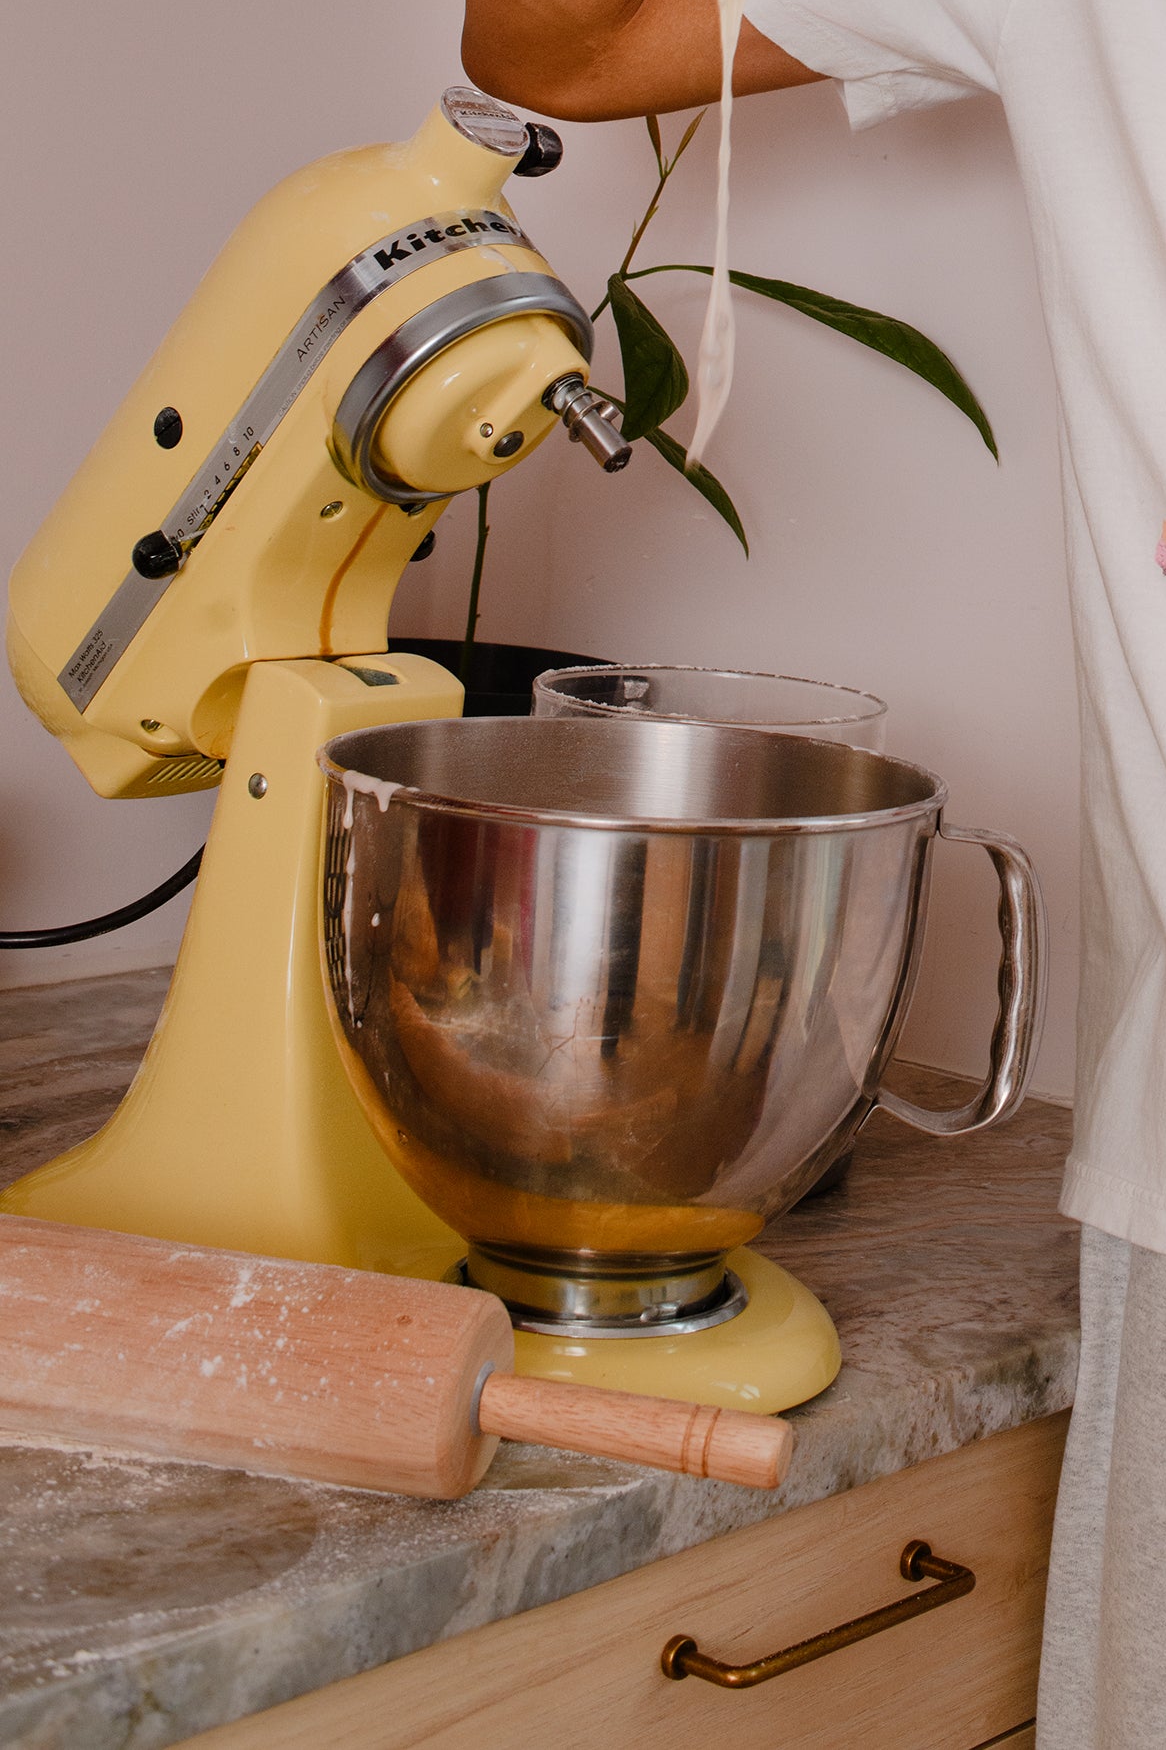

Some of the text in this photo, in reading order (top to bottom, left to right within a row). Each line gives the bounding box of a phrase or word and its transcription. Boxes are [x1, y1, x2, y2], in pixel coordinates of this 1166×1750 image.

[297, 296, 346, 362] ARTISAN
[187, 507, 200, 525] Stir
[204, 490, 212, 499] 2
[215, 475, 221, 485] 4
[224, 462, 230, 471] 6
[233, 447, 240, 456] 8
[243, 426, 254, 440] 10
[68, 662, 82, 678] Max
[77, 641, 107, 683] KitchenAid
